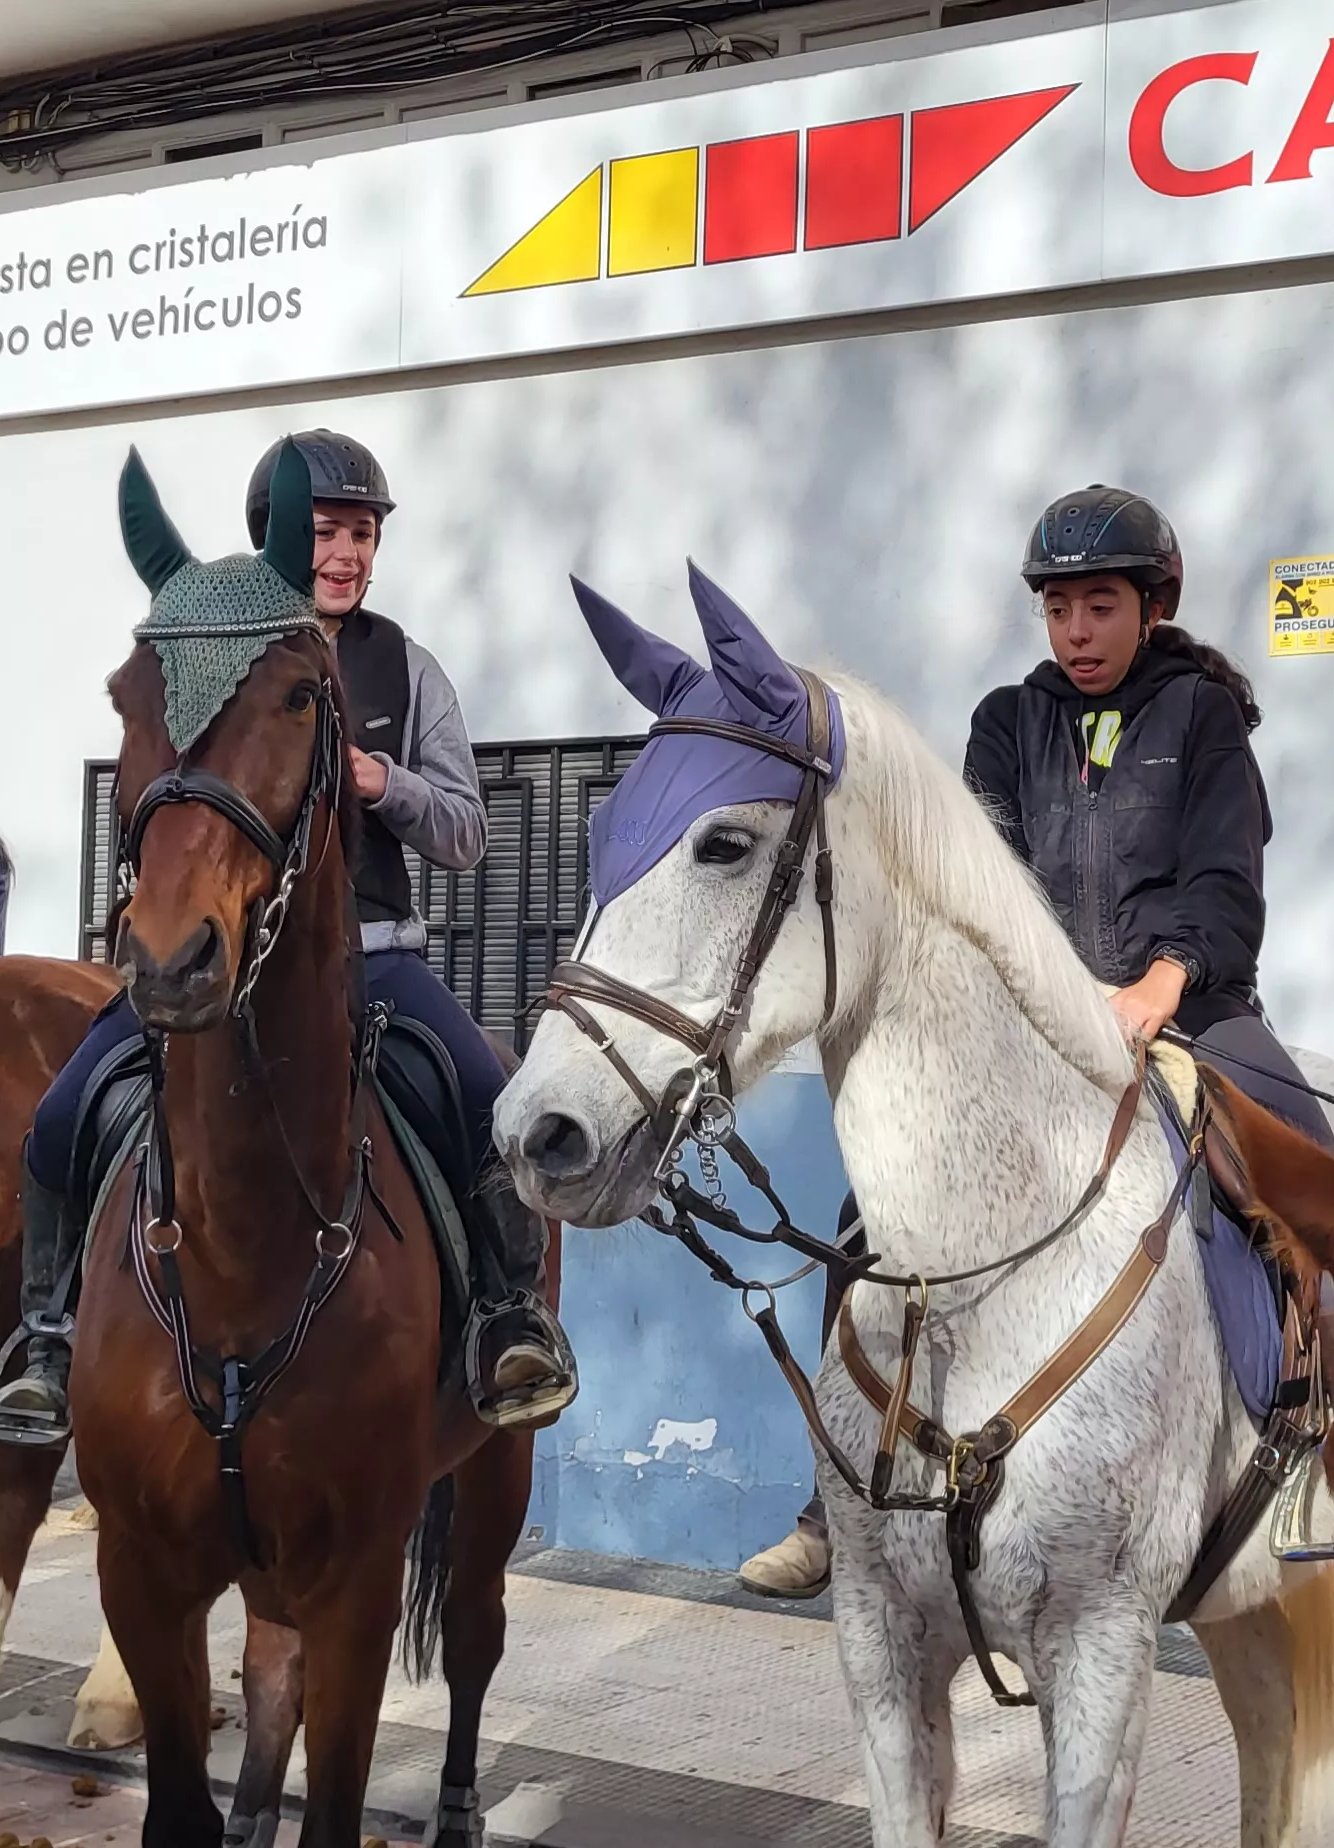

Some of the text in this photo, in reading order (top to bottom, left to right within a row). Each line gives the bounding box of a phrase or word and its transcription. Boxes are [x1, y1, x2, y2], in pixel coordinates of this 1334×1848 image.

[66, 249, 114, 285] en
[128, 203, 328, 275] cristalería
[43, 308, 94, 351] de
[107, 282, 302, 342] vehículos
